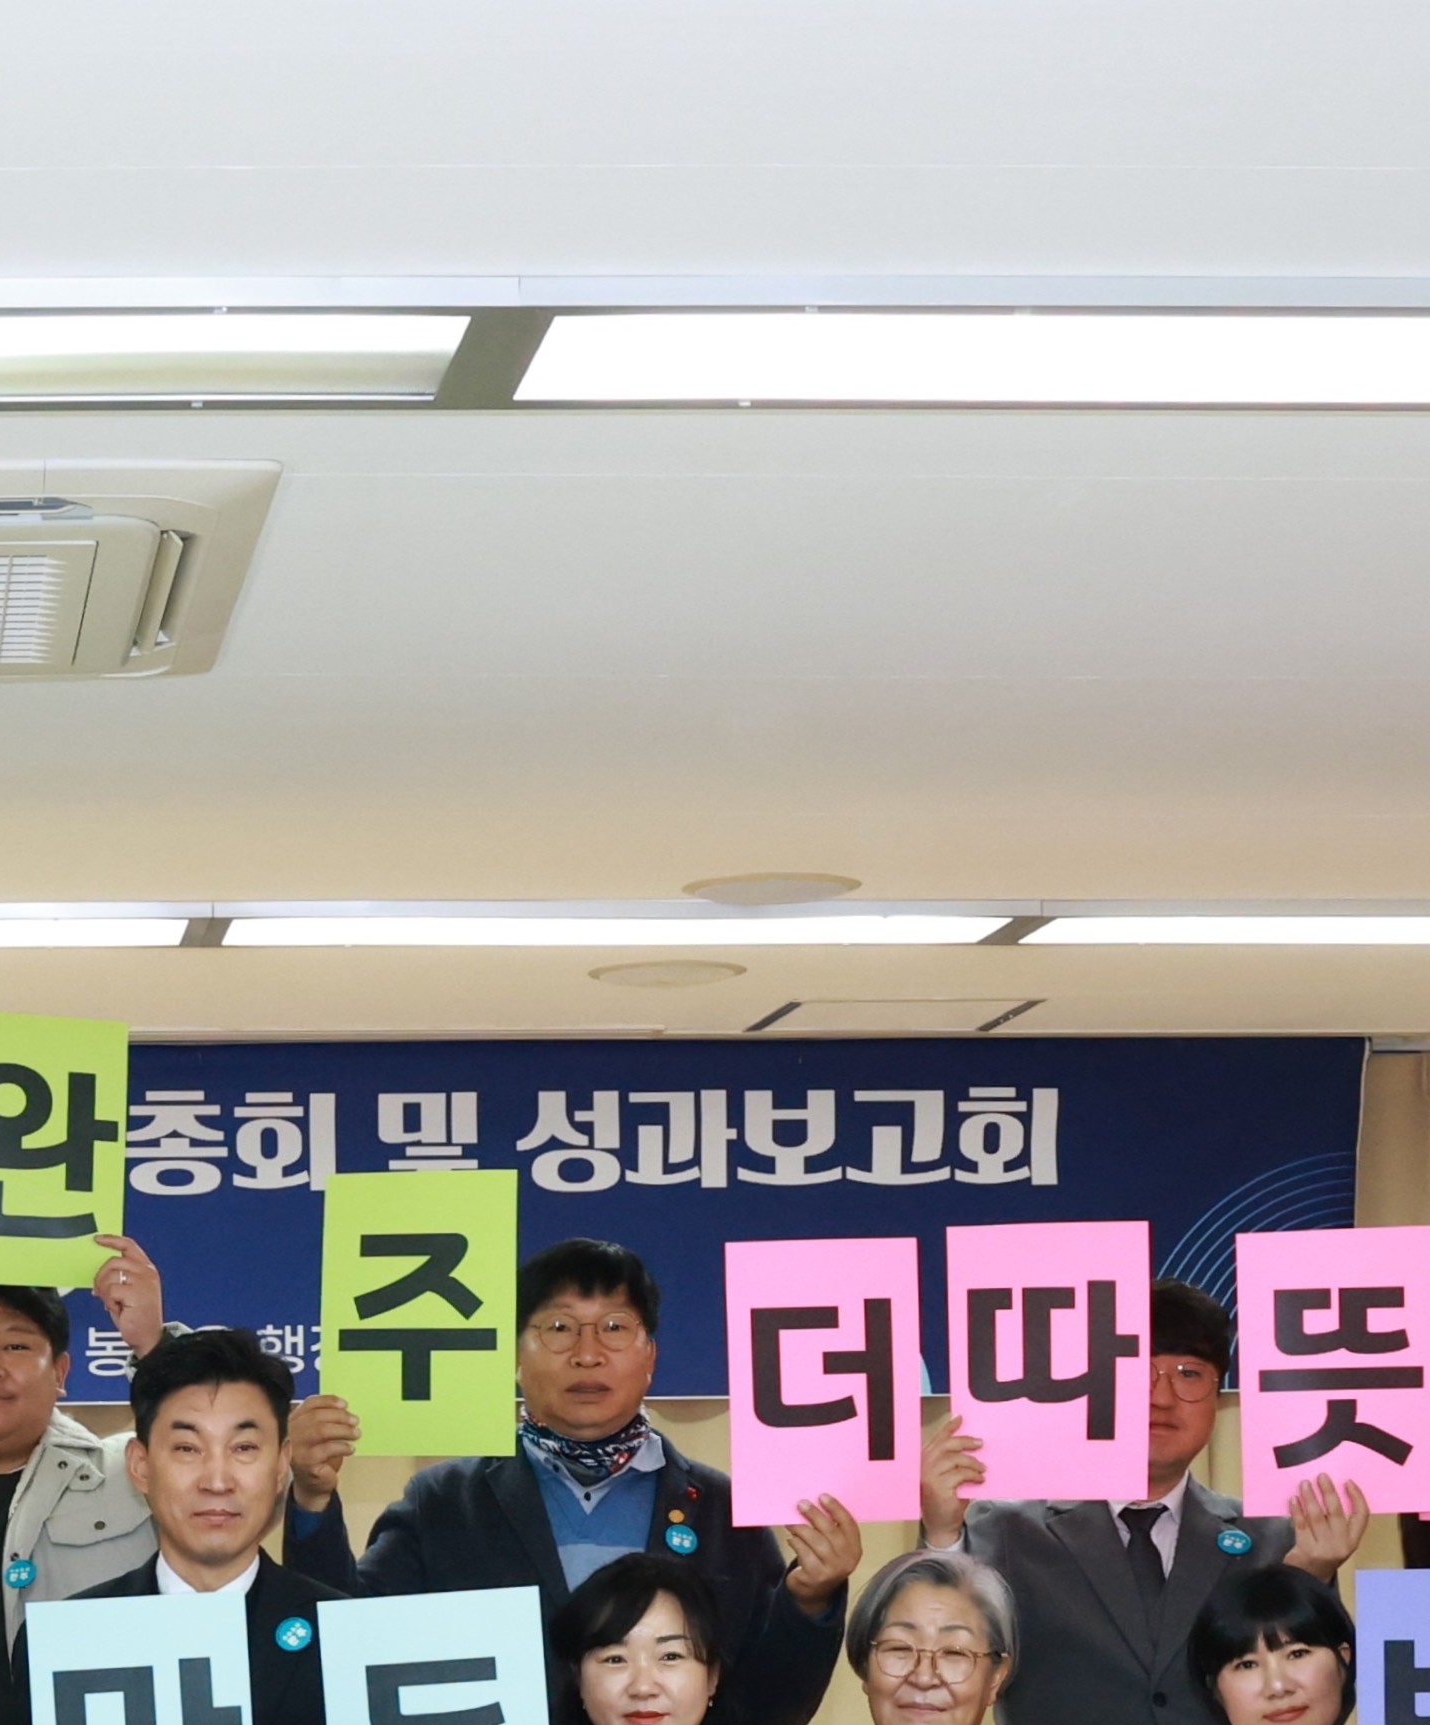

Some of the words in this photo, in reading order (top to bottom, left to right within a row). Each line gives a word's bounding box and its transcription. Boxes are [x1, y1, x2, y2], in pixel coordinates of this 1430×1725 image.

[515, 1086, 1060, 1193] 성과보고회
[339, 1233, 496, 1400] 주
[752, 1299, 893, 1460] 더
[969, 1282, 1138, 1439] 따
[1262, 1288, 1422, 1467] 뜻
